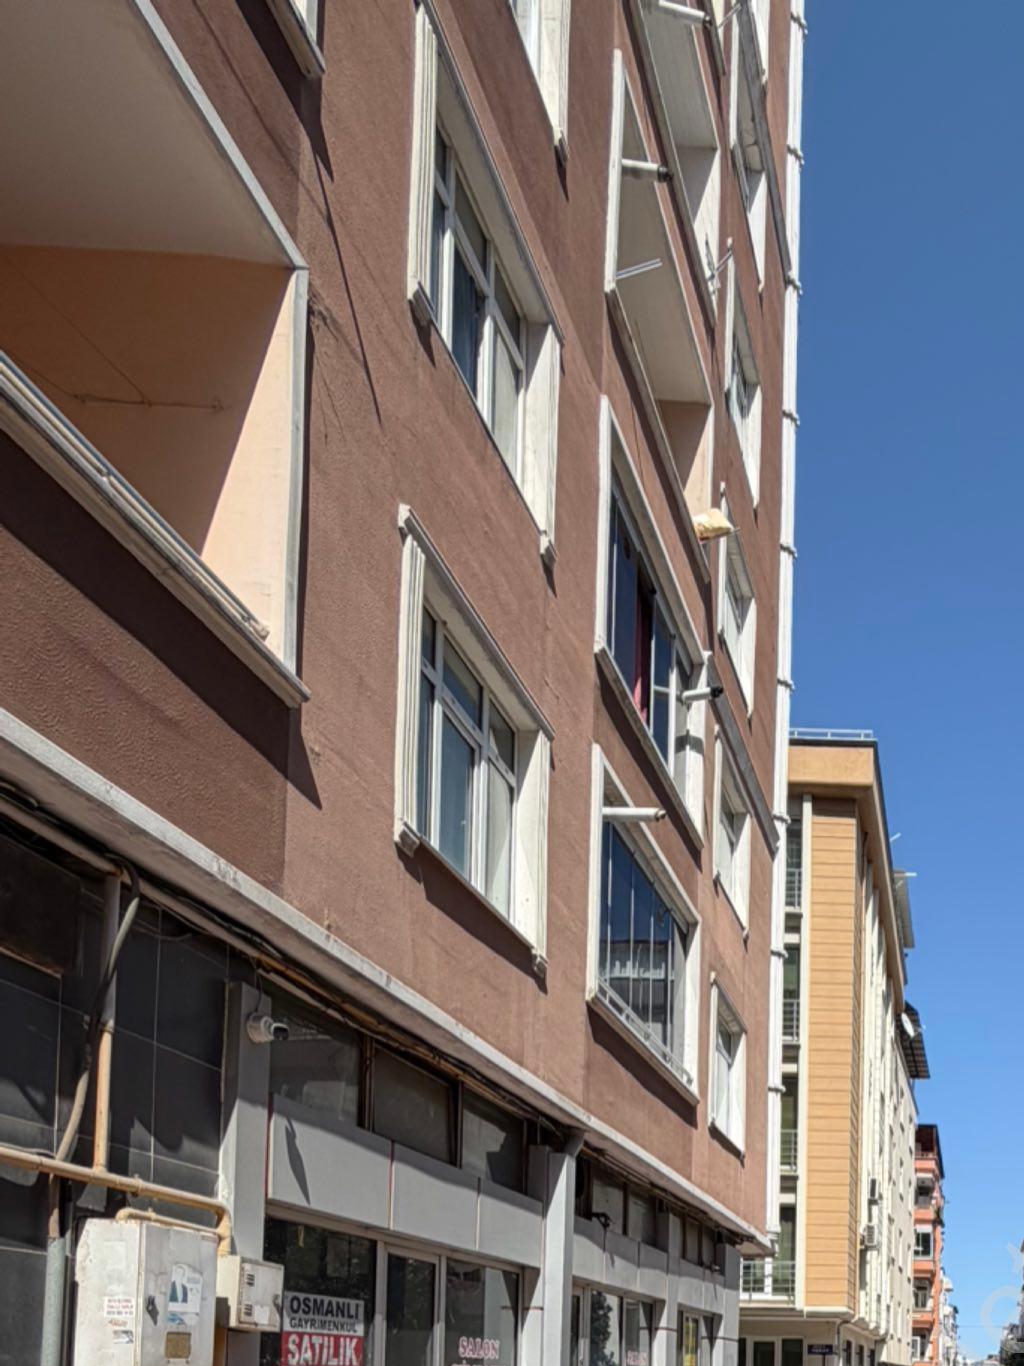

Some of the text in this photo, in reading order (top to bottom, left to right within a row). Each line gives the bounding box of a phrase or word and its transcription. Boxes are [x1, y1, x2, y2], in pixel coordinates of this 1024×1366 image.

[289, 1295, 360, 1320] OSMANLI
[287, 1333, 360, 1366] SATILIK
[458, 1336, 500, 1360] SALON
